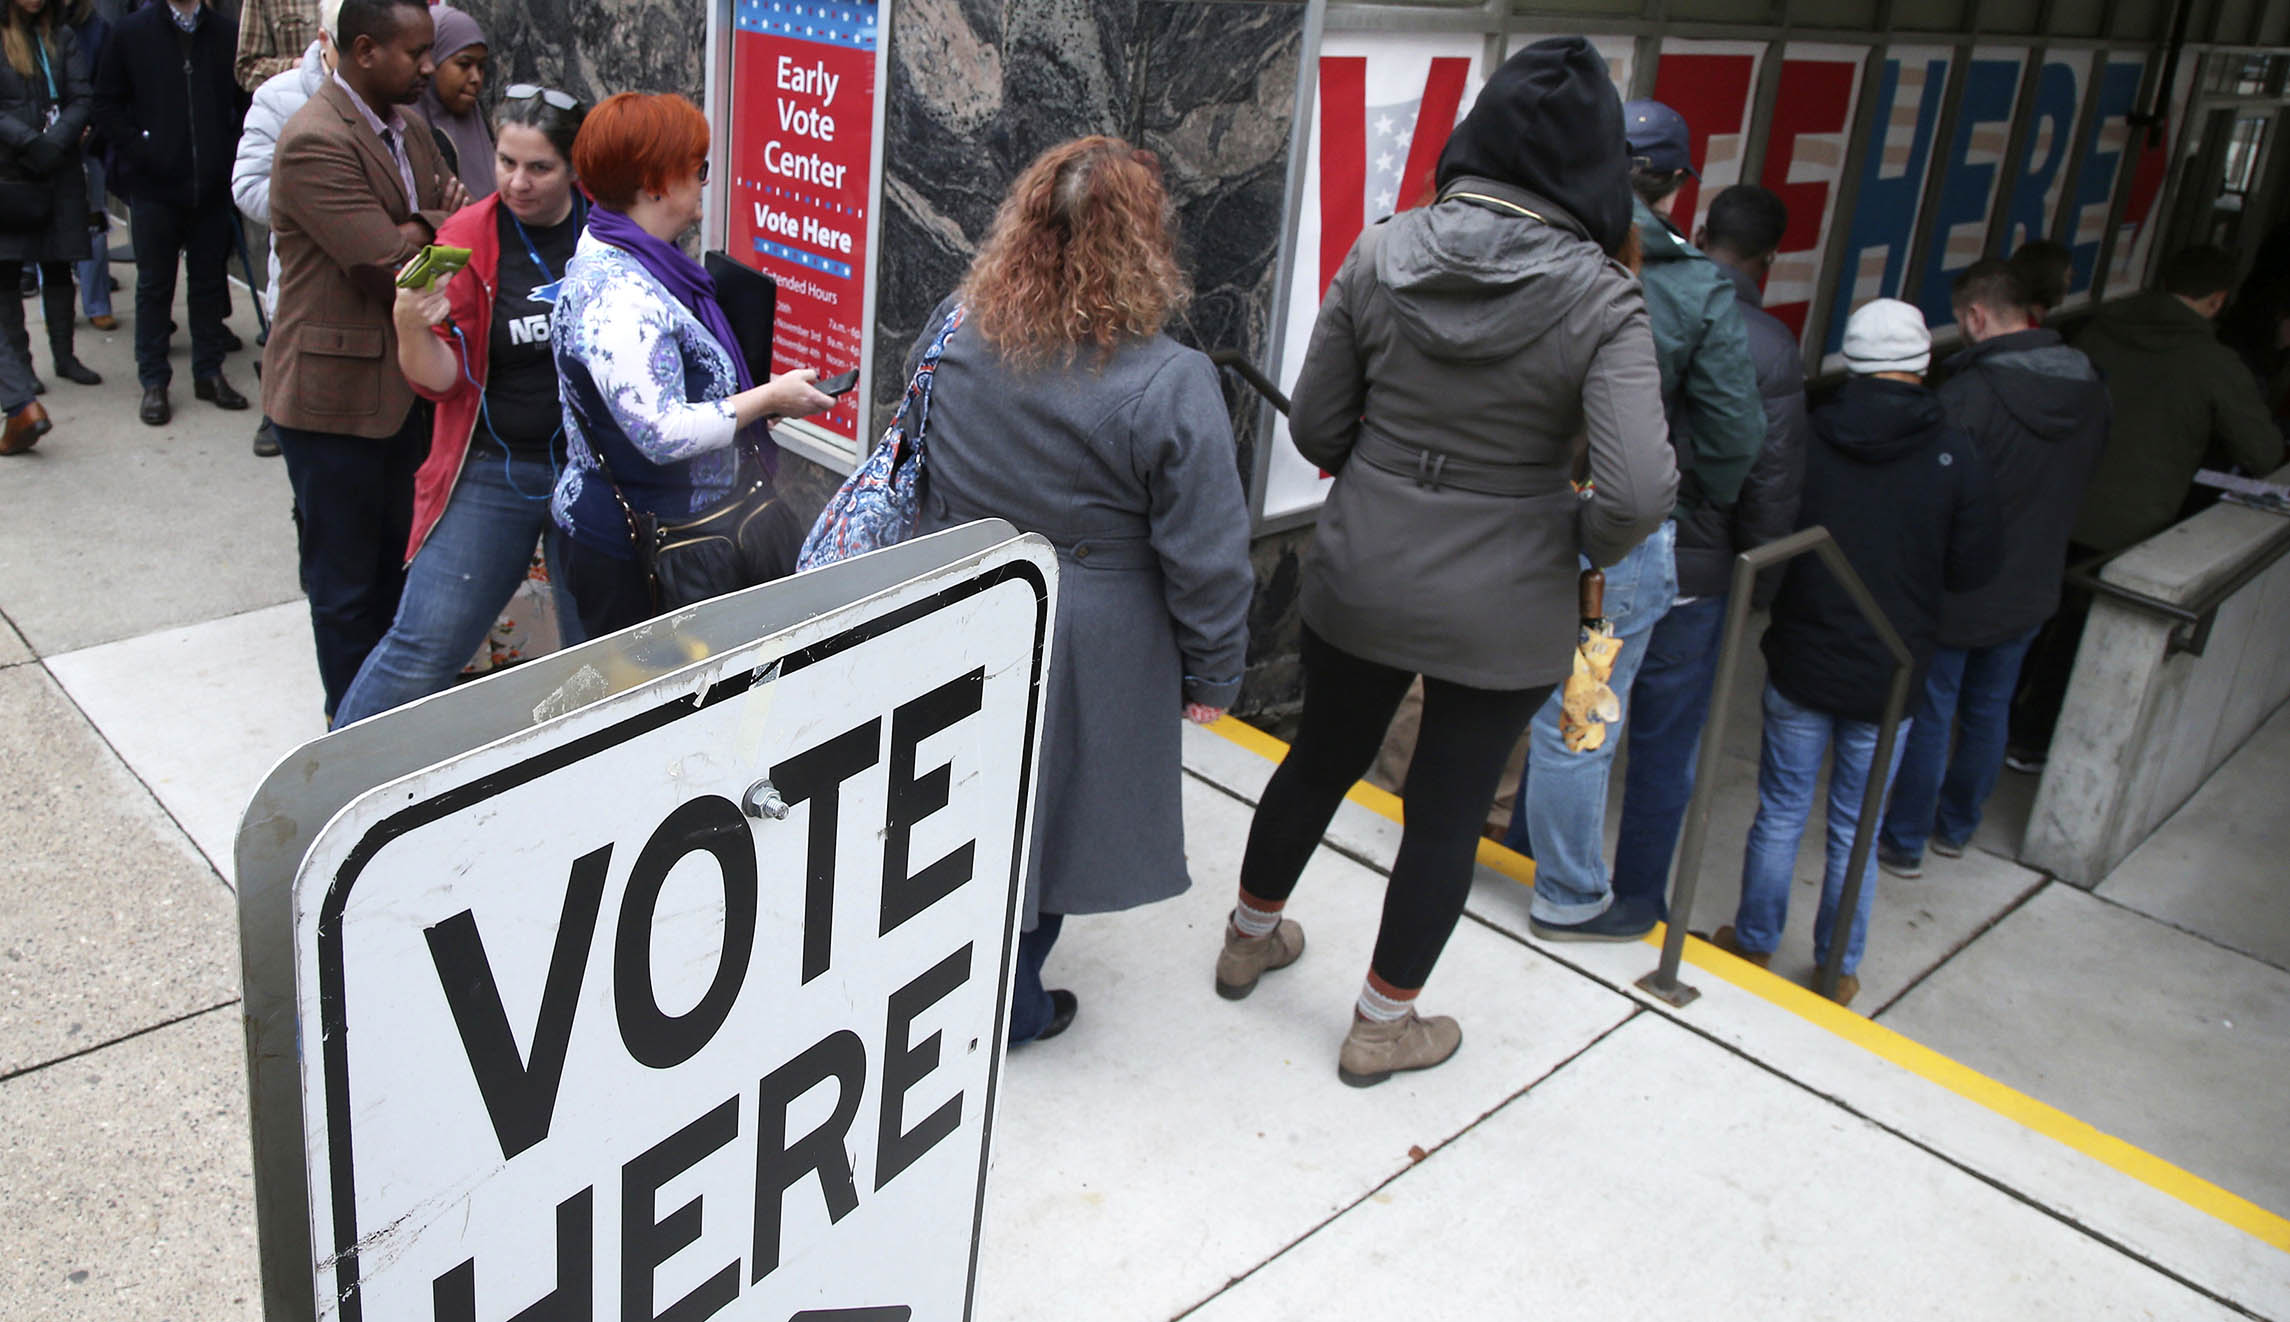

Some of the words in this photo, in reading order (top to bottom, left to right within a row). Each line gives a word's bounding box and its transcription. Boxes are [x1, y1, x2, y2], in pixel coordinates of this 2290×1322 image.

[776, 56, 840, 107] Early
[777, 98, 836, 142] Vote
[764, 140, 847, 190] Center
[754, 202, 799, 239] Vote
[802, 215, 852, 254] Here
[762, 267, 807, 295] Etended
[808, 282, 838, 305] Hours
[422, 664, 986, 1161] VOTE
